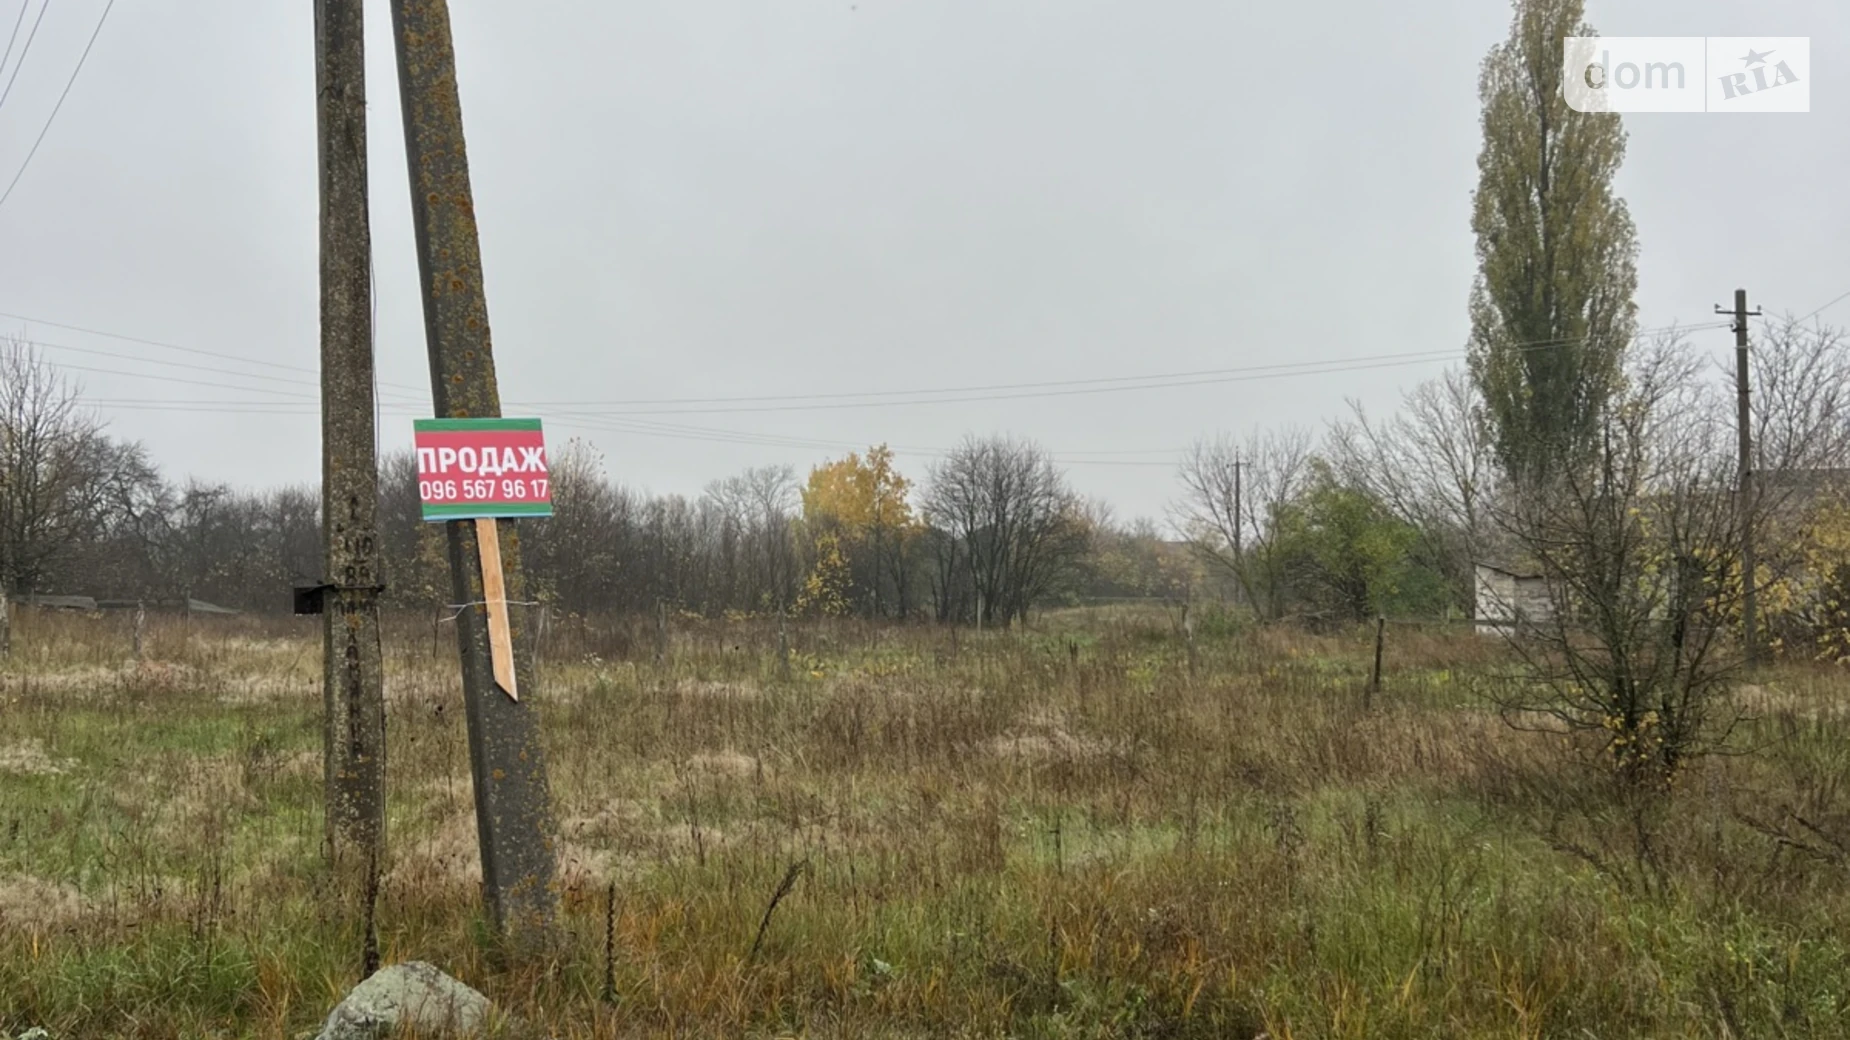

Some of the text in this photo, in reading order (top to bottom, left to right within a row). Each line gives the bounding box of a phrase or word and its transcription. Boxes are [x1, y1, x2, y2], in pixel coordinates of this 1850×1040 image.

[417, 447, 547, 476] ПРОДАЖ
[419, 479, 548, 500] 096 567 96 17
